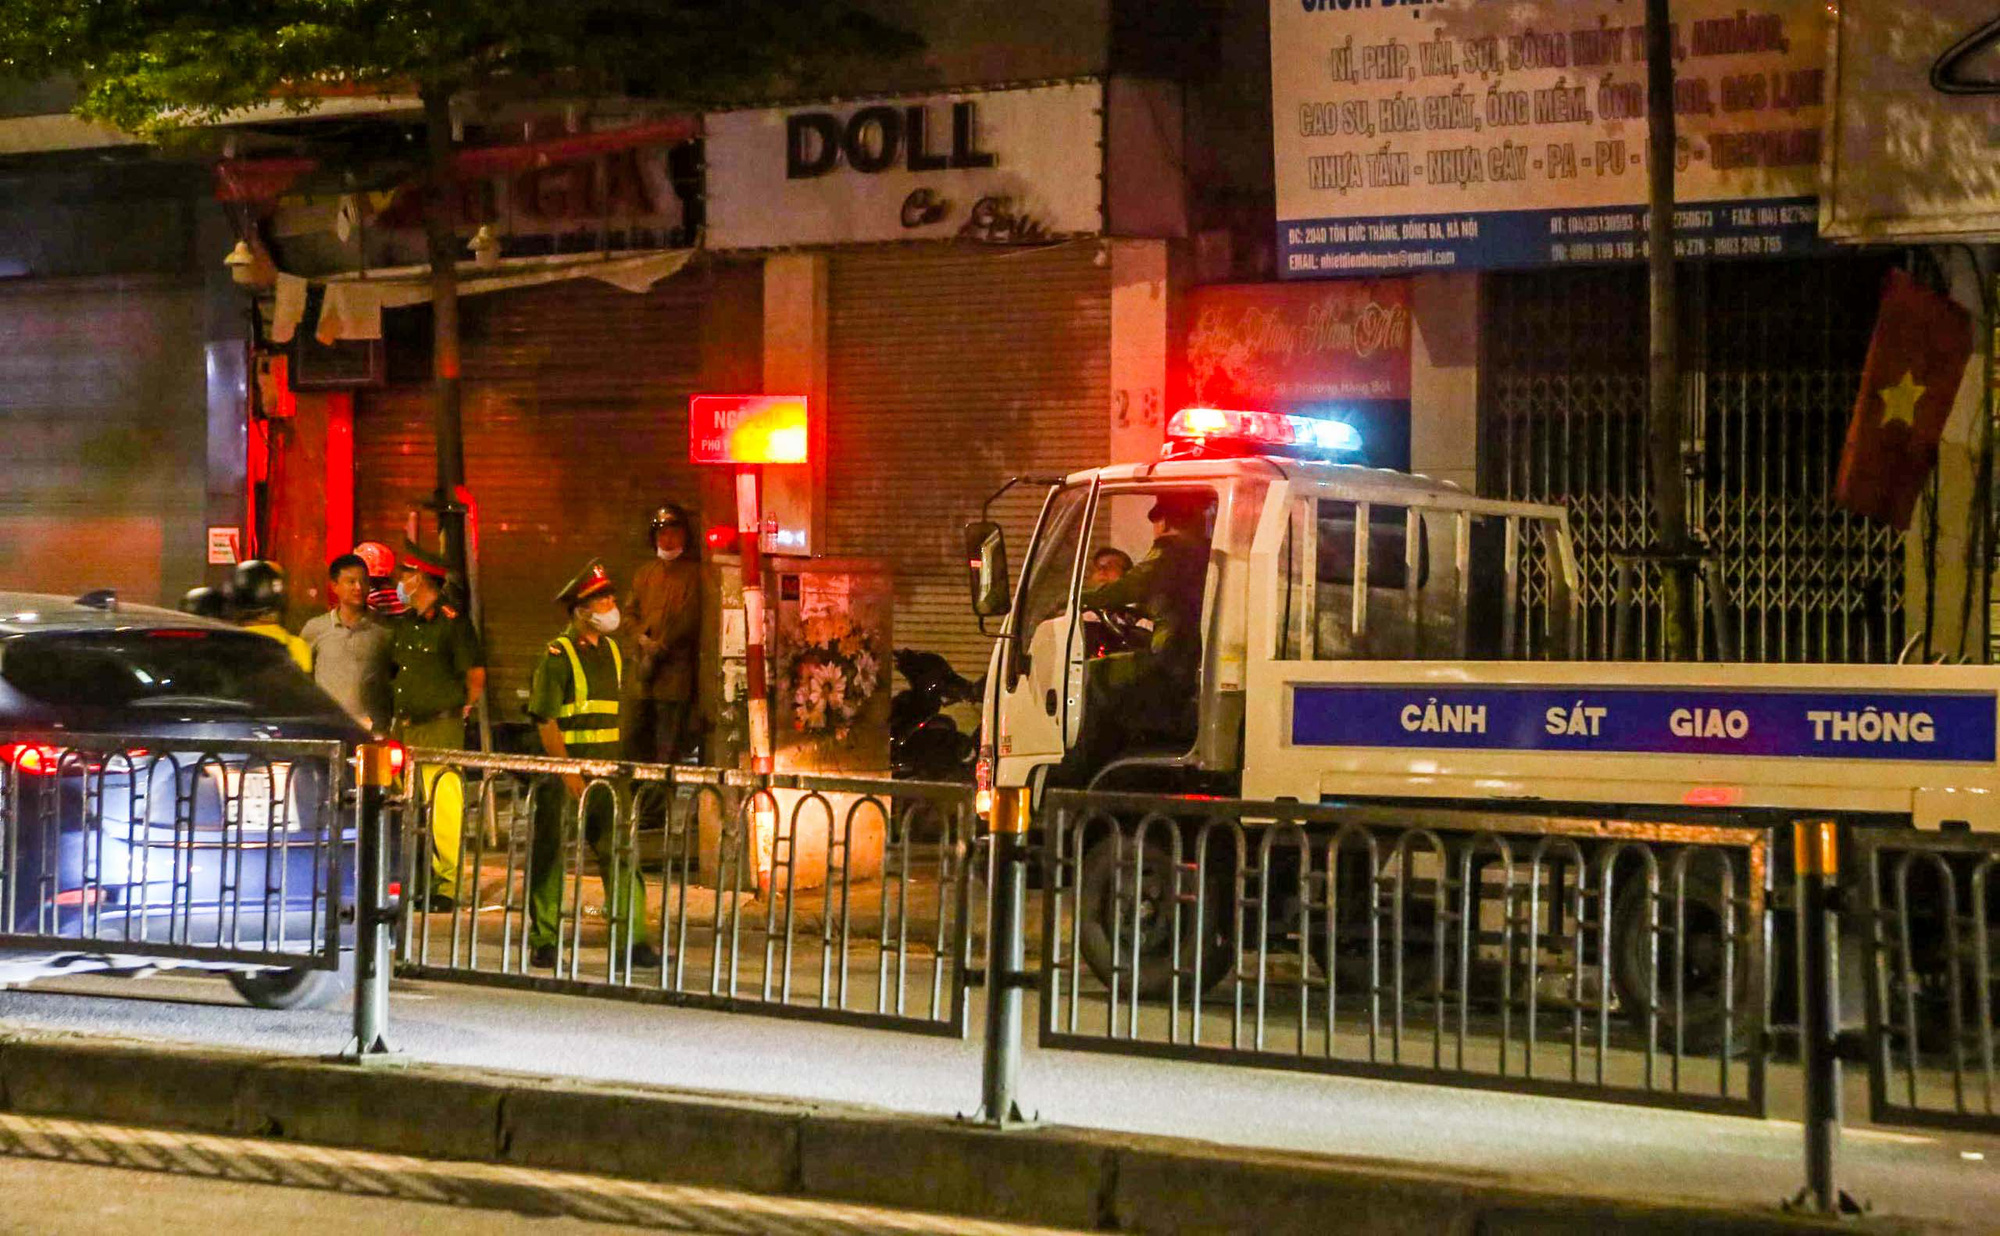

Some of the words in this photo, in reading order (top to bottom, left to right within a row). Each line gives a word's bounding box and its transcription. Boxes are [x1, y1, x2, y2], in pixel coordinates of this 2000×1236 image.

[786, 101, 999, 180] DOLL
[1300, 102, 1338, 137] CAO
[1547, 143, 1578, 179] PA
[1594, 140, 1626, 176] PU
[1400, 697, 1487, 734] CẢNH
[1546, 700, 1607, 737] SÁT
[1669, 708, 1750, 740] GIAO
[1807, 704, 1936, 744] THÔNG
